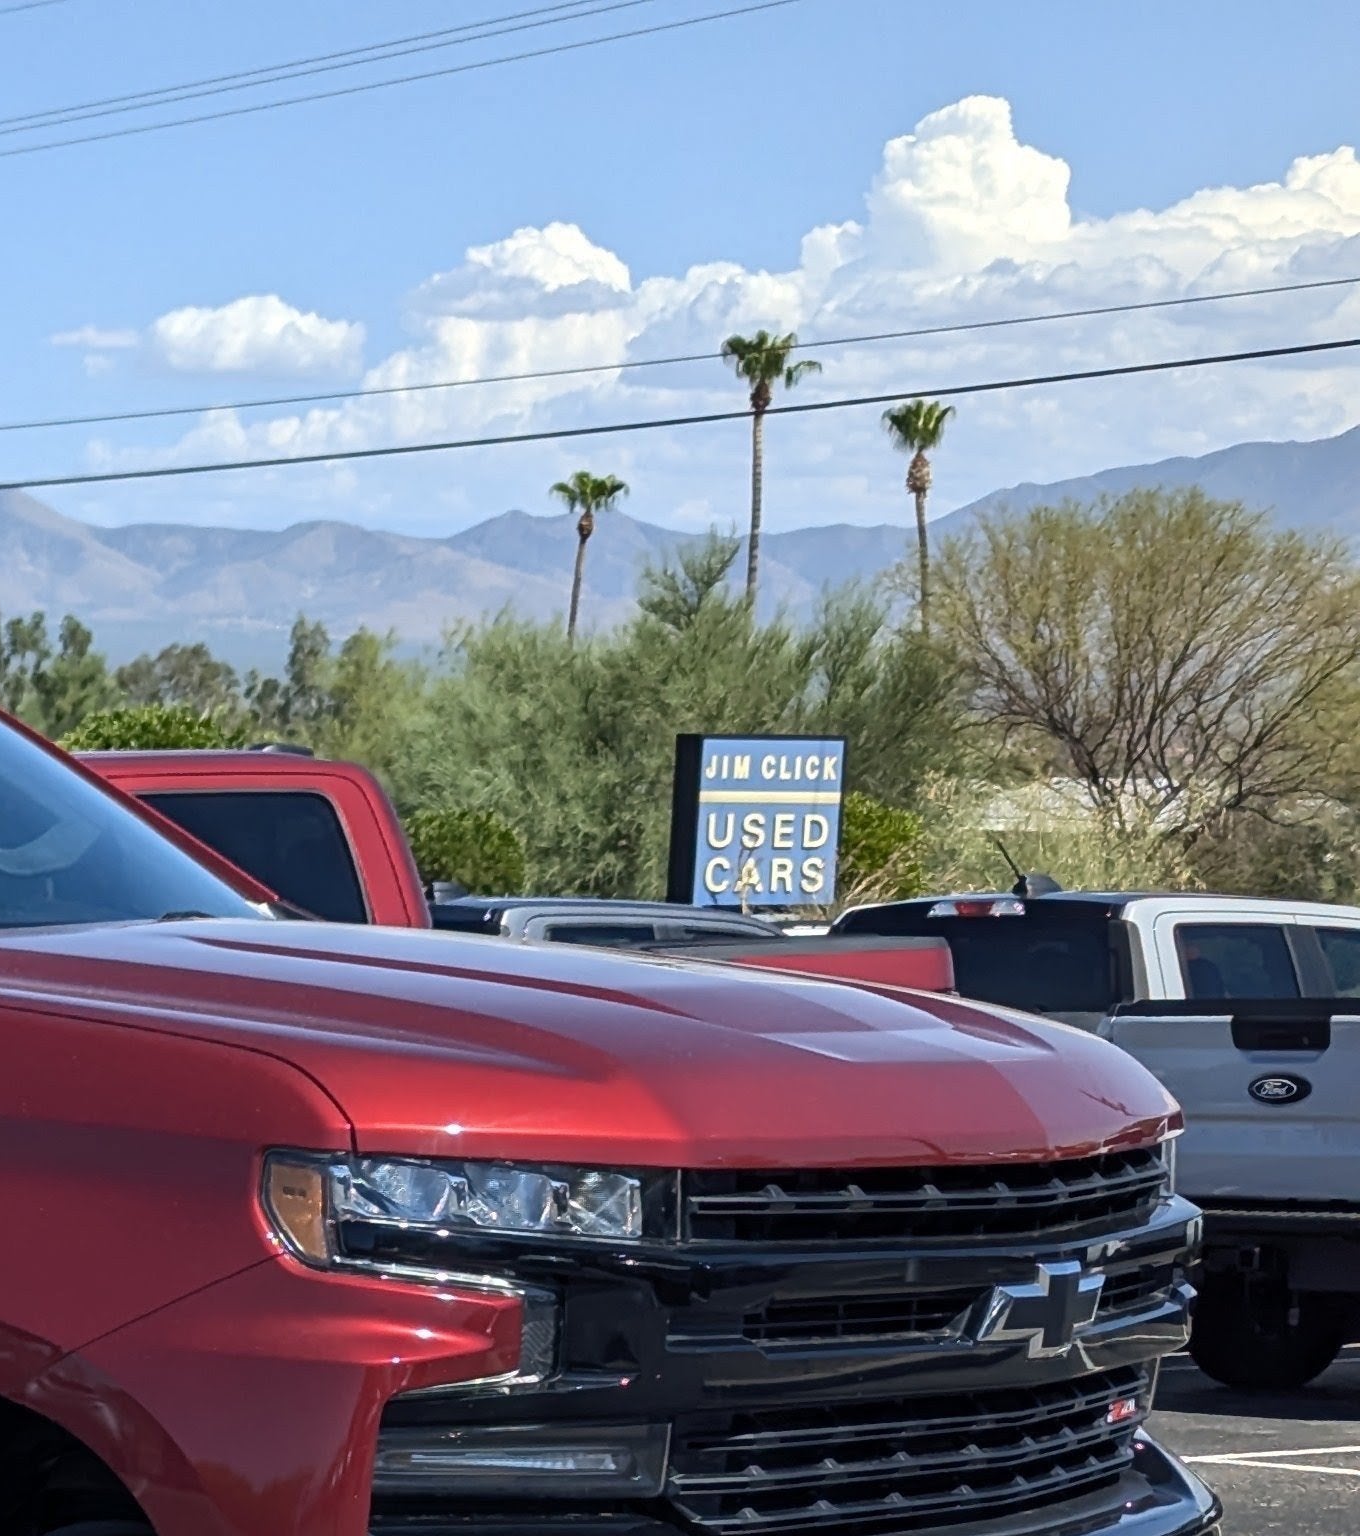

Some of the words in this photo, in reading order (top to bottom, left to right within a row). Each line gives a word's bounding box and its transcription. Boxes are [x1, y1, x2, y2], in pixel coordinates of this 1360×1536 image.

[705, 754, 751, 780] JIM
[761, 754, 838, 781] CLICK
[707, 813, 830, 849] USED
[704, 857, 826, 893] CARS
[1260, 1080, 1290, 1096] Ford
